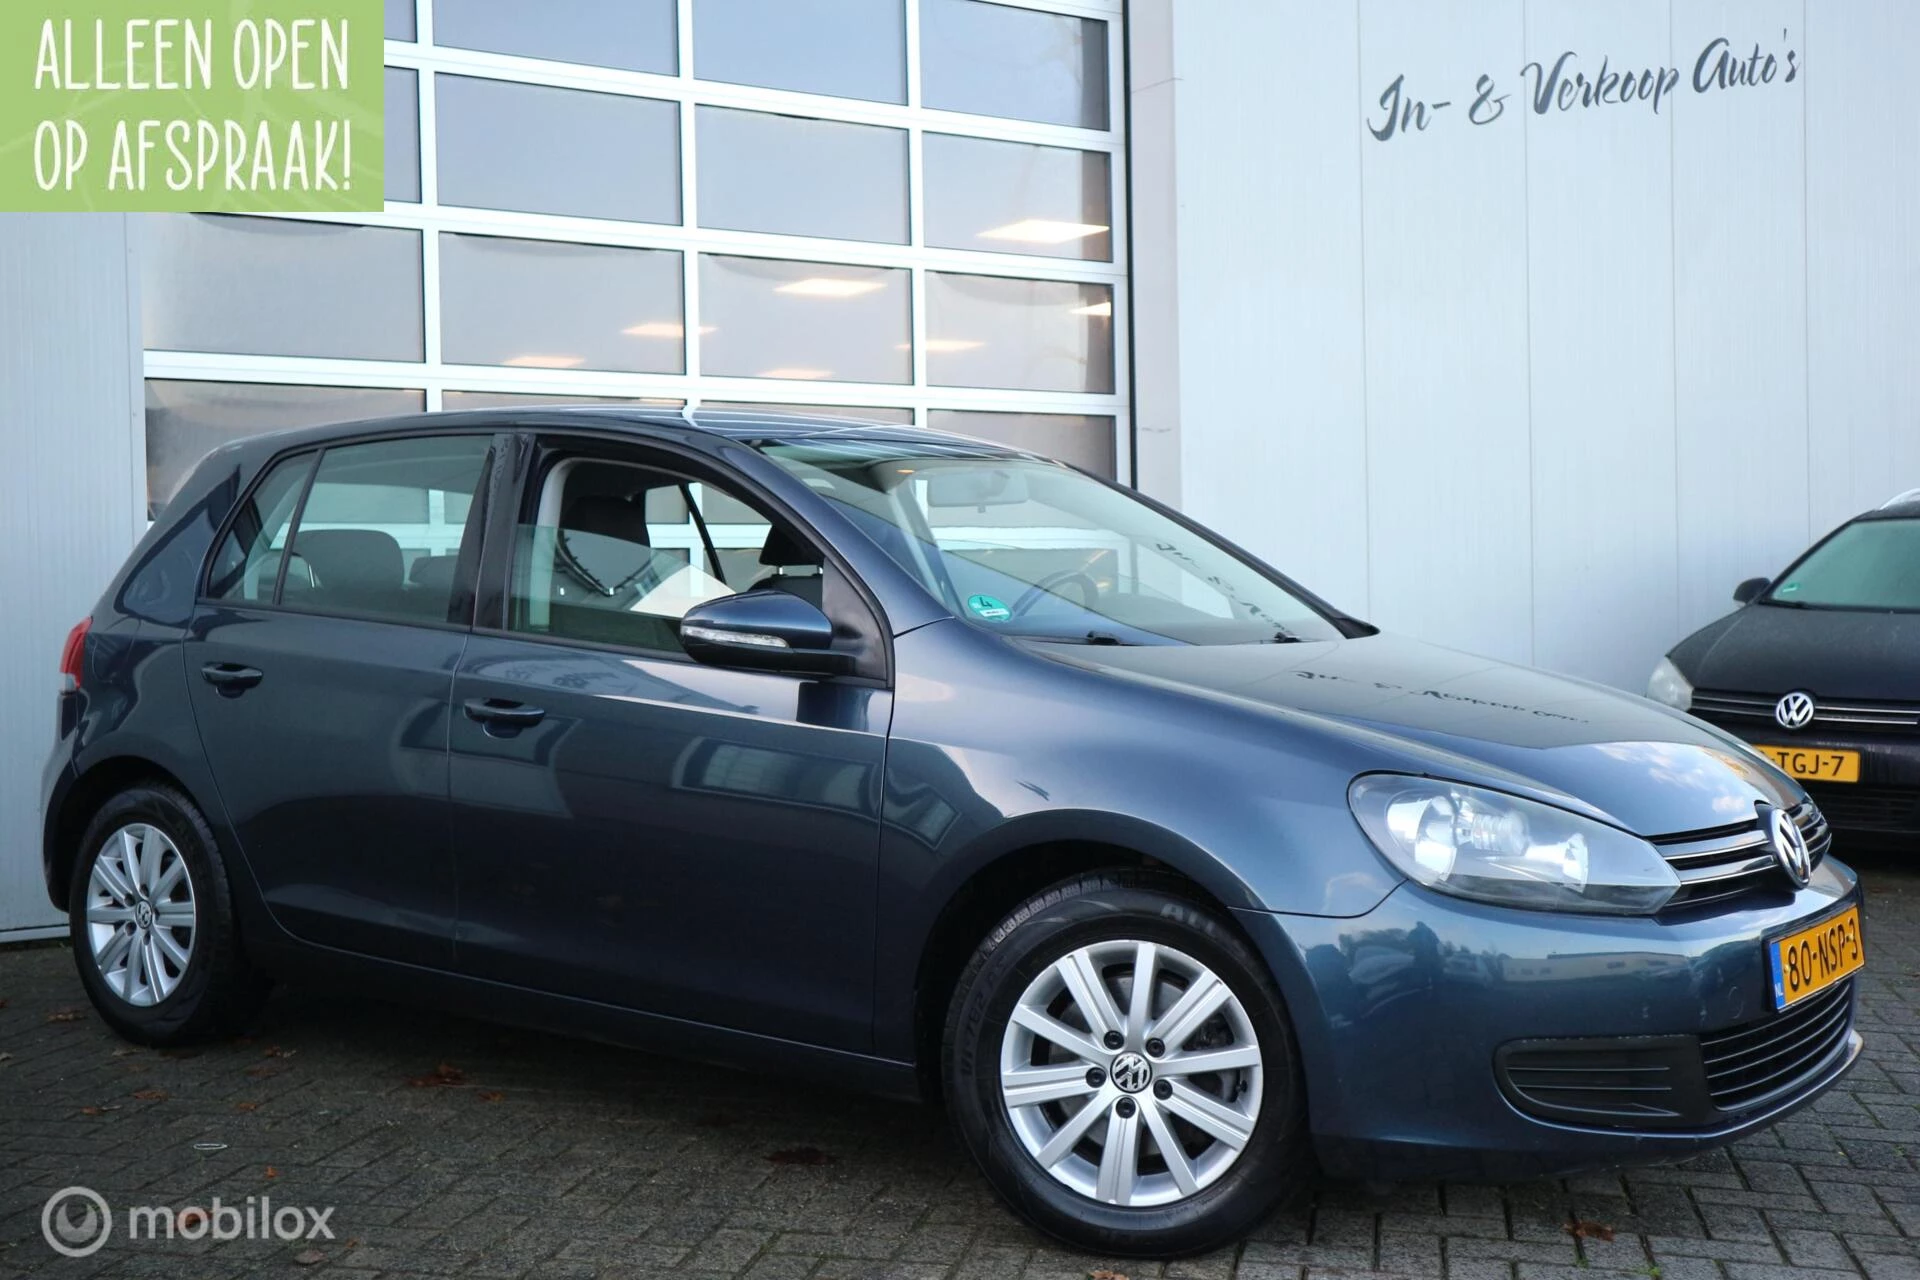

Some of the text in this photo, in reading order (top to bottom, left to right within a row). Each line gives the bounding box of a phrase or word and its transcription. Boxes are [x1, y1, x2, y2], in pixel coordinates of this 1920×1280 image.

[1367, 27, 1800, 142] In- & Verkoop Auto's
[1787, 917, 1858, 992] 80-NSP-3
